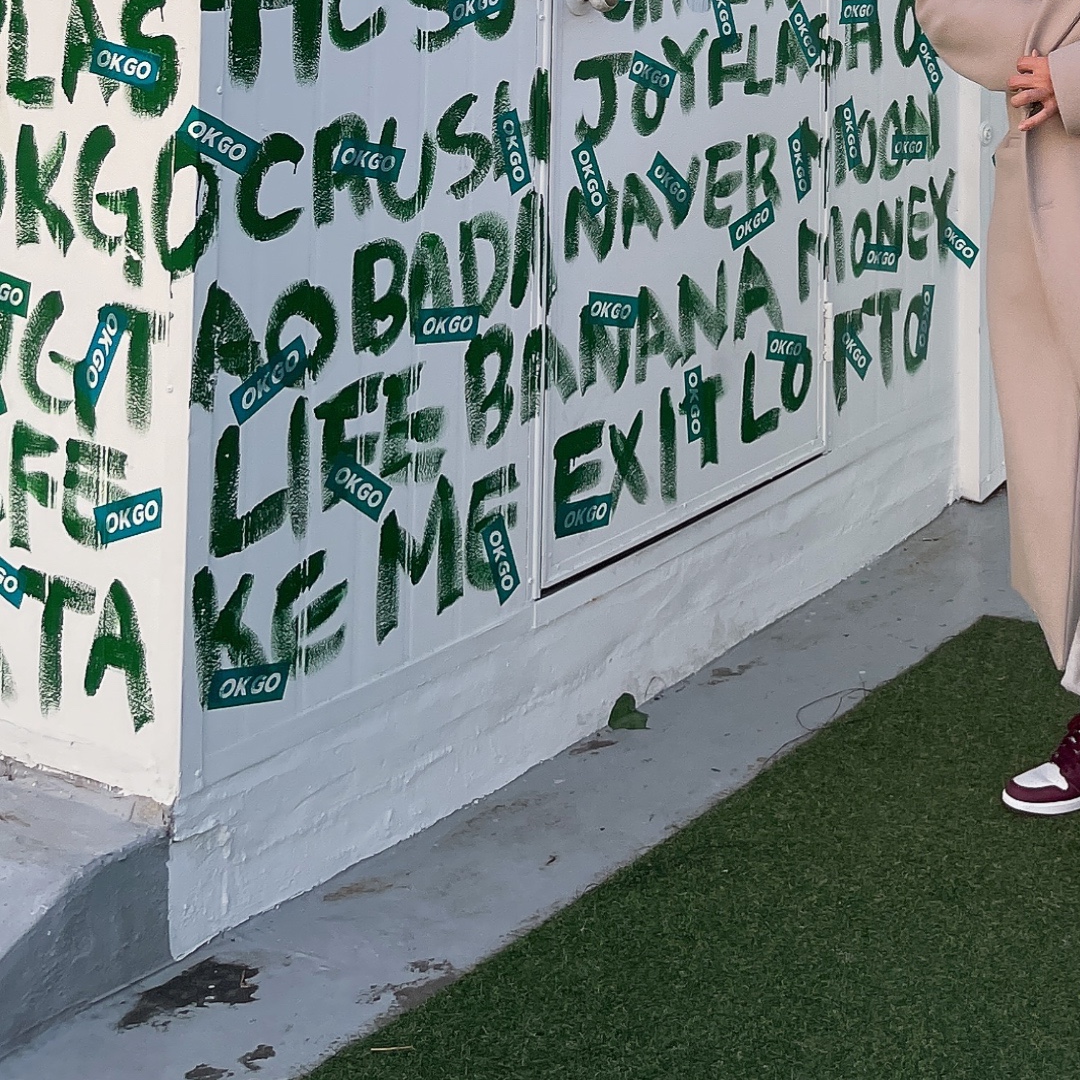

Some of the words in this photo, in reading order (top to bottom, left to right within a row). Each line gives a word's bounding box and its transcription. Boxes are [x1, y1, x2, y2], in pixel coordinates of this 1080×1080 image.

[844, 4, 874, 18] OKGO
[502, 119, 525, 183] OKGO
[735, 207, 770, 240] OKGO
[943, 226, 974, 258] OKGO
[590, 301, 631, 320] OKGO
[335, 467, 384, 507] OKGO
[105, 500, 159, 531] OKGO
[218, 671, 283, 699] OKGO
